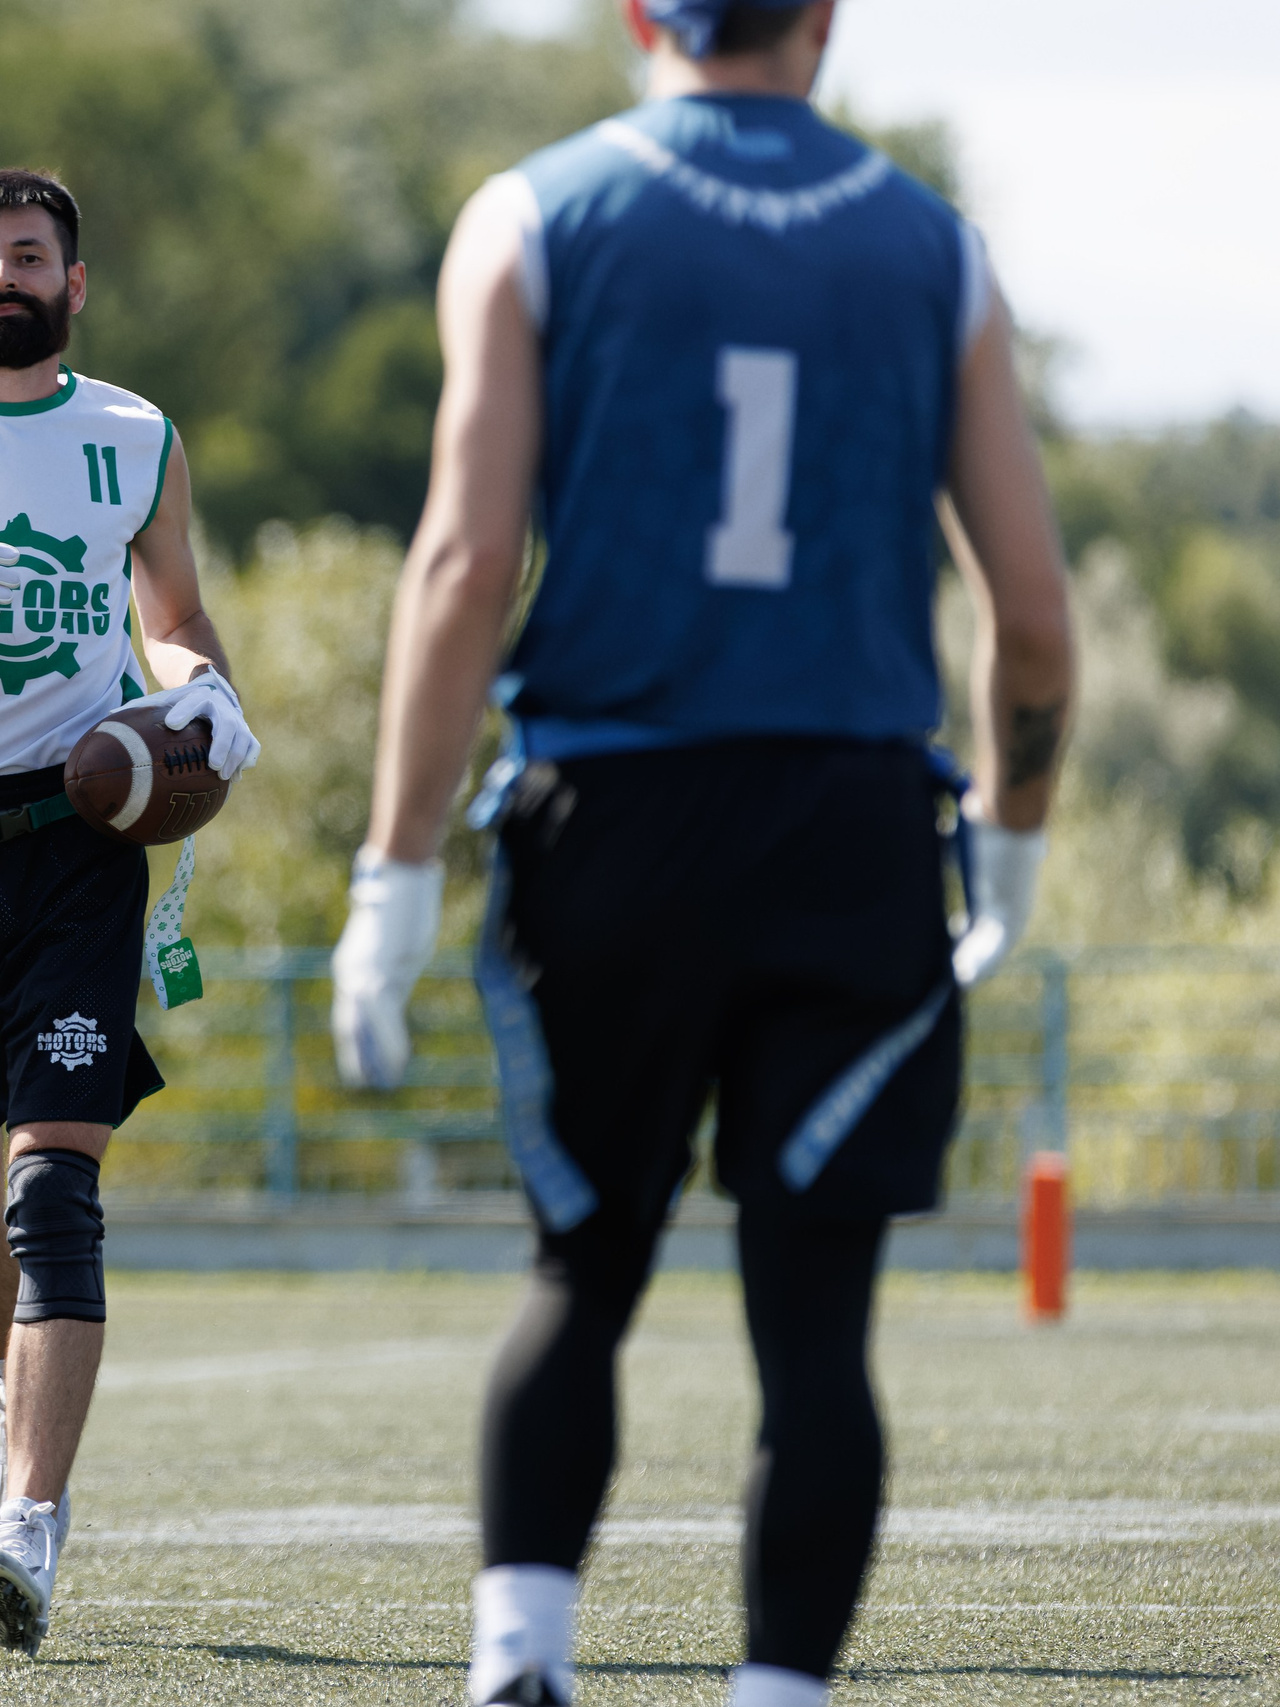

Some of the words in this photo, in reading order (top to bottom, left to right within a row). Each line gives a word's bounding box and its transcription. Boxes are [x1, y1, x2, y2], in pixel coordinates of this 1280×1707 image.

[82, 443, 122, 505] 11
[708, 347, 796, 589] 1
[160, 949, 193, 970] MOTORS
[37, 1032, 107, 1053] MOTORS
